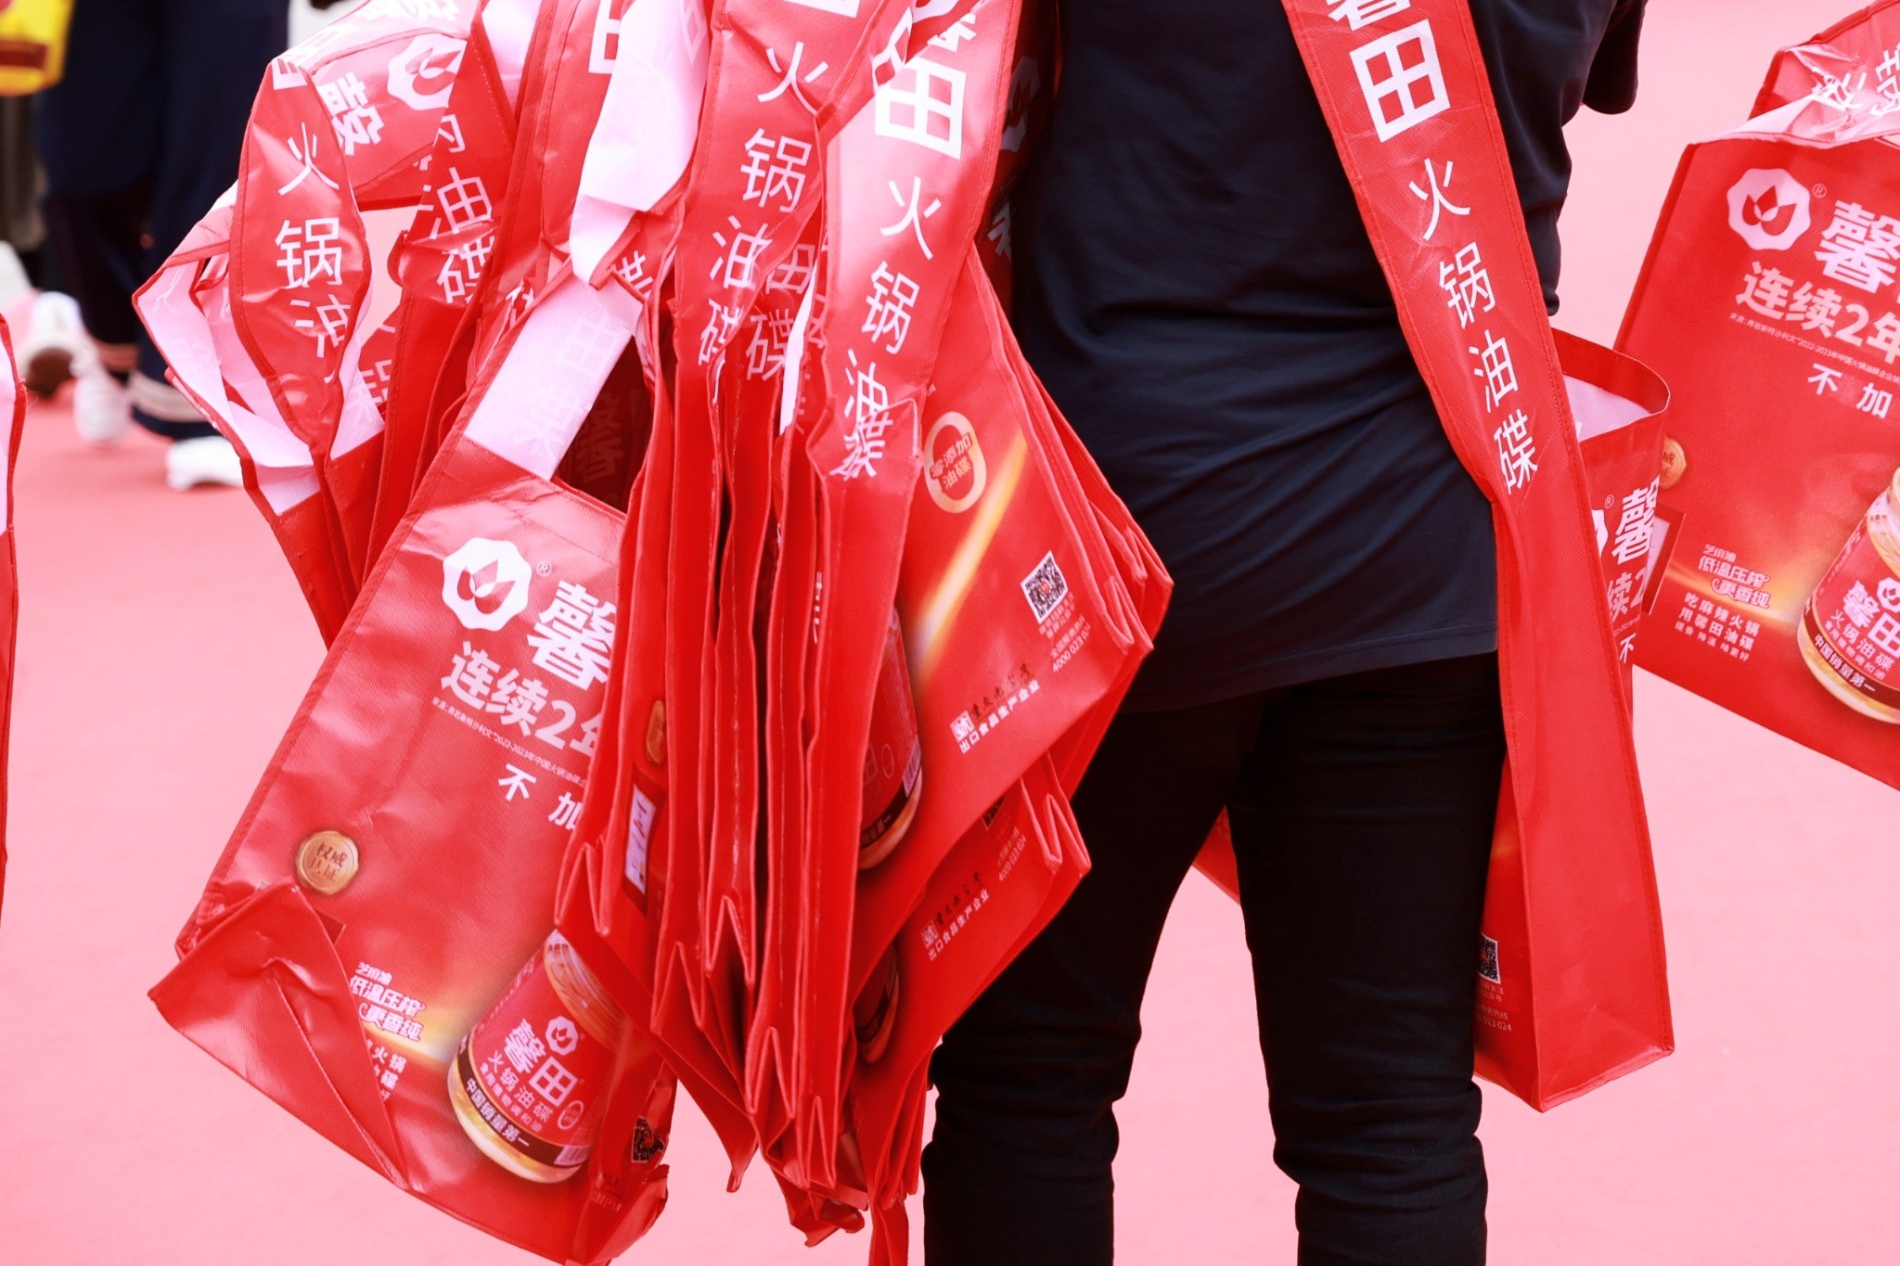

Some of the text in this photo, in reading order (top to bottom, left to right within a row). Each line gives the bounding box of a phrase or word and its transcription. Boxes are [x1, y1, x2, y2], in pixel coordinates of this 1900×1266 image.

[1408, 158, 1539, 495] 火锅油碟
[1698, 555, 1770, 589] 低温压榨
[1814, 634, 1876, 693] 中国销量第一
[1829, 611, 1894, 671] 火锅油碟
[487, 1048, 554, 1123] 火锅油碟
[504, 1018, 579, 1108] 馨田
